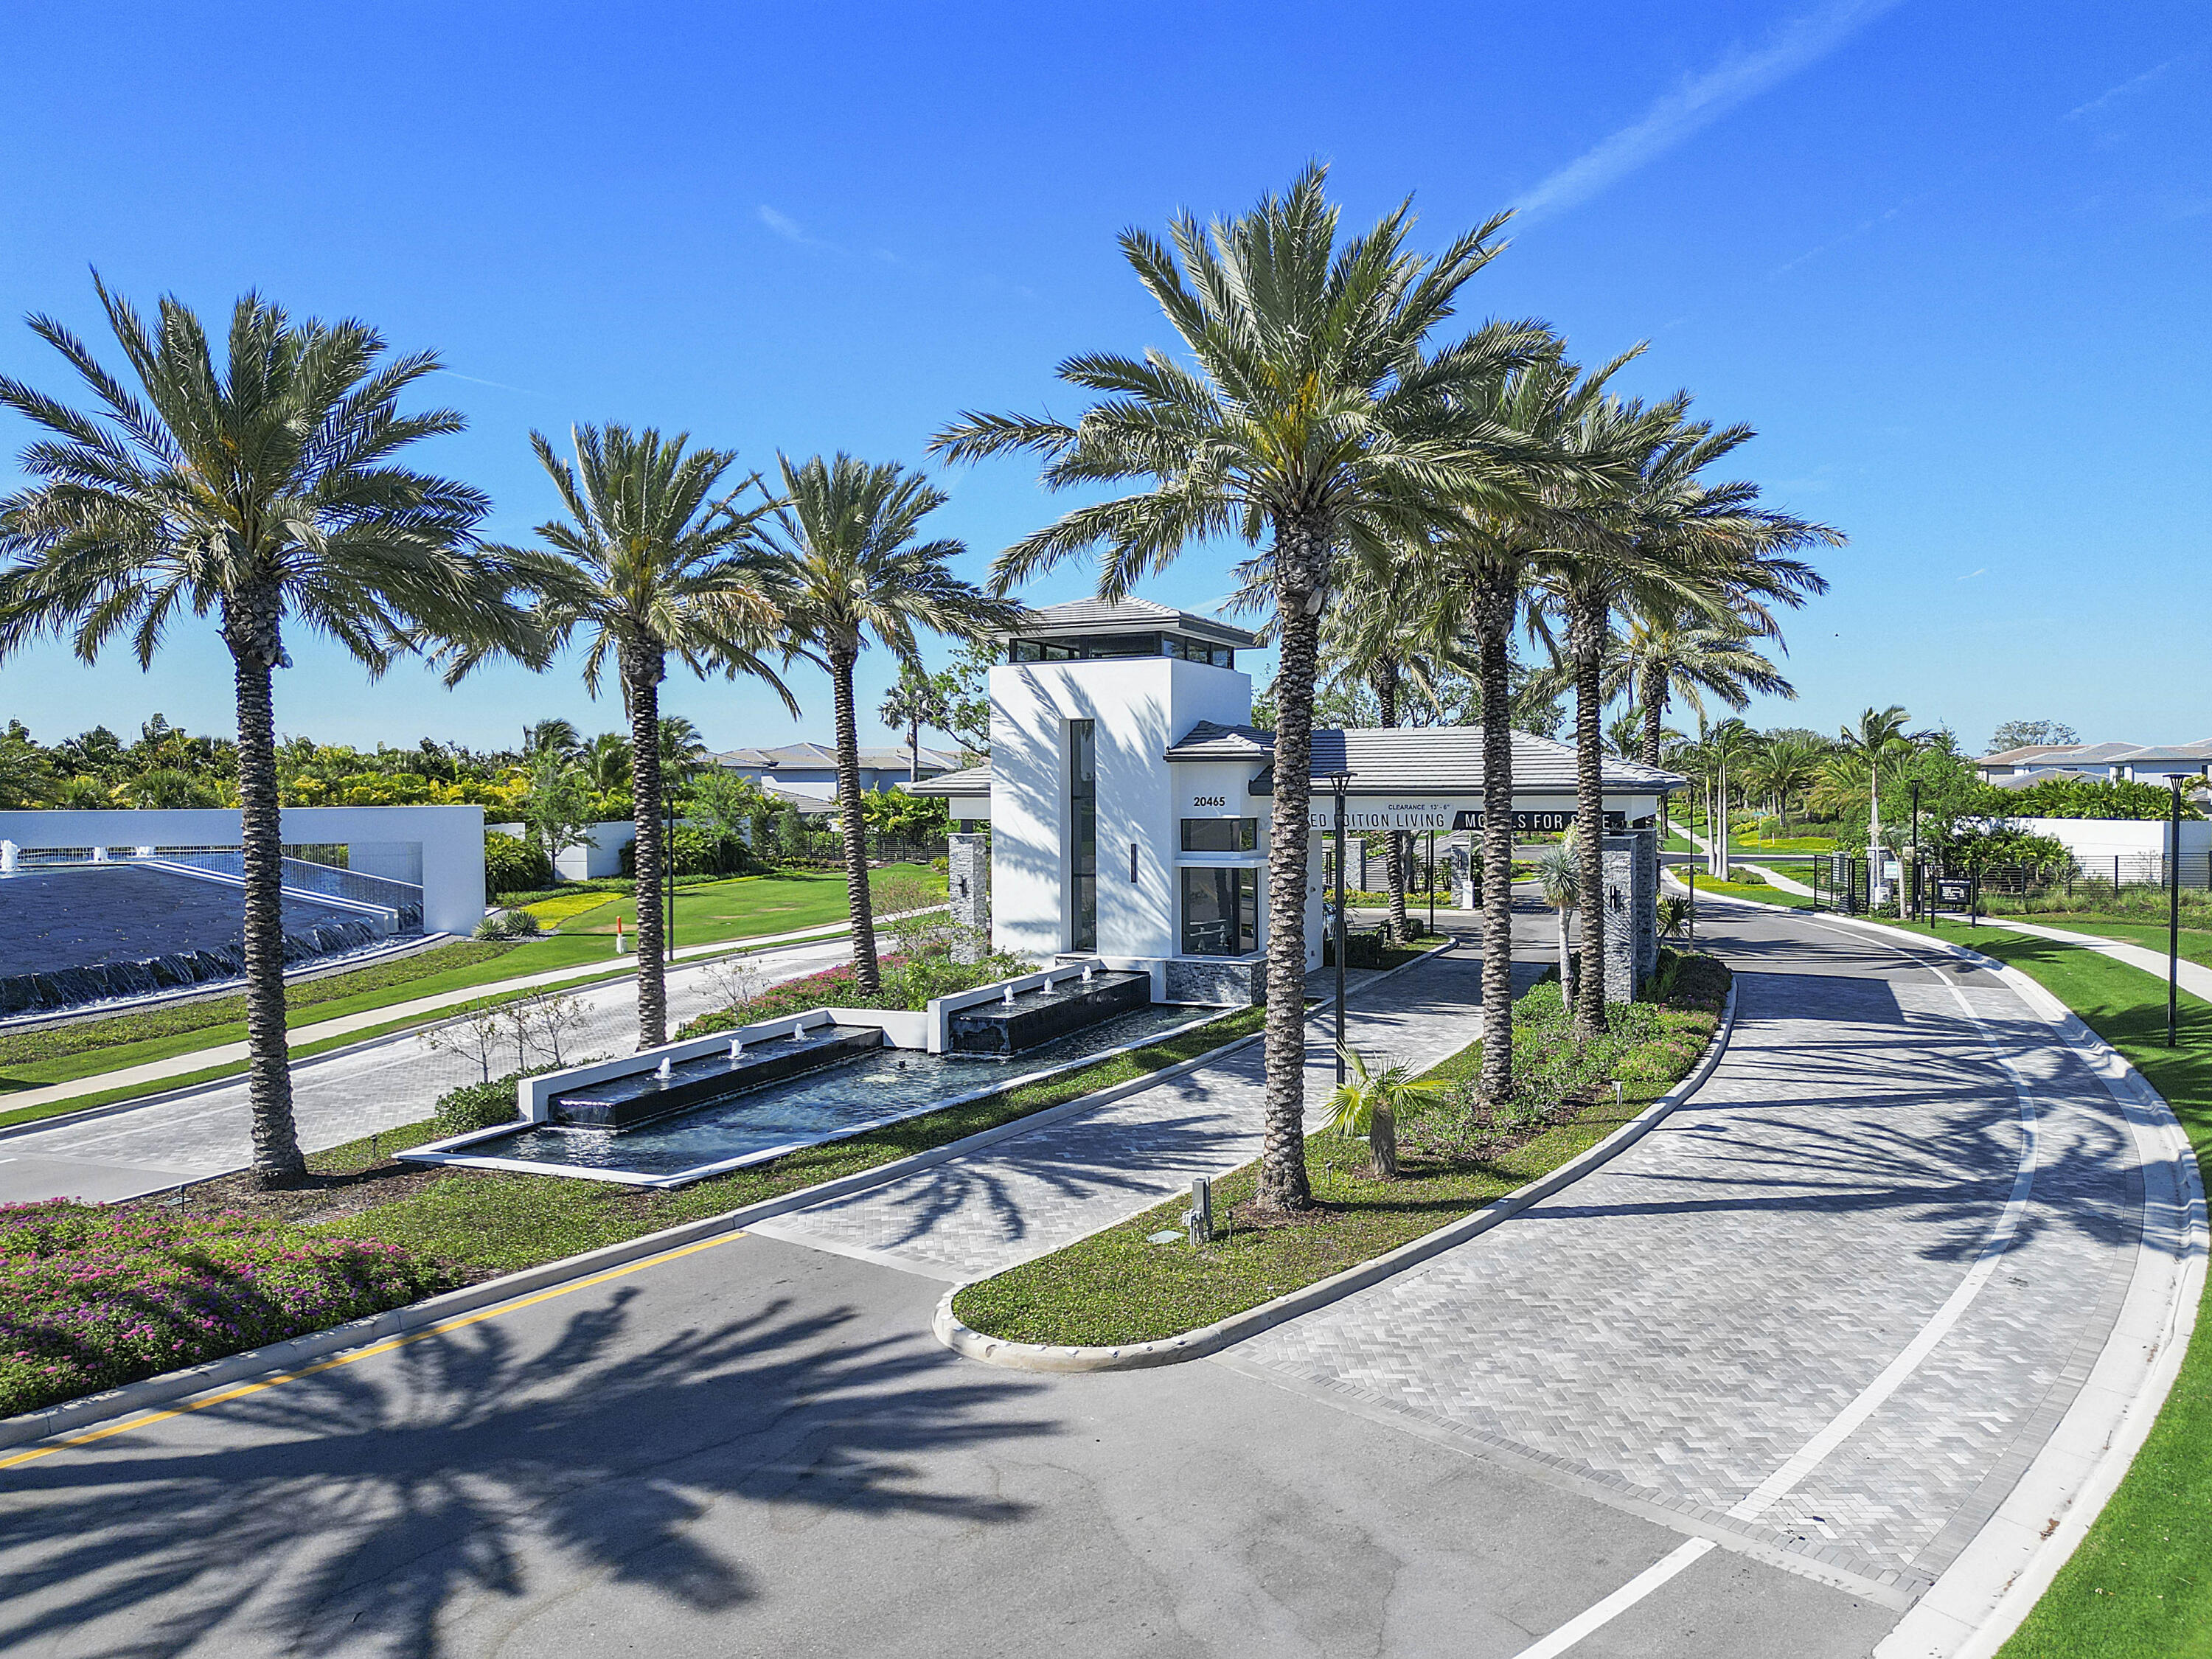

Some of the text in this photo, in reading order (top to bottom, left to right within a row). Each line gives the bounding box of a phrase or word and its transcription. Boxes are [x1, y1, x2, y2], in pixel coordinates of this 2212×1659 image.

[1194, 797, 1225, 807] 20465
[1334, 813, 1389, 827] DITION
[1397, 813, 1444, 827] LIVING
[1534, 814, 1563, 830] FOR
